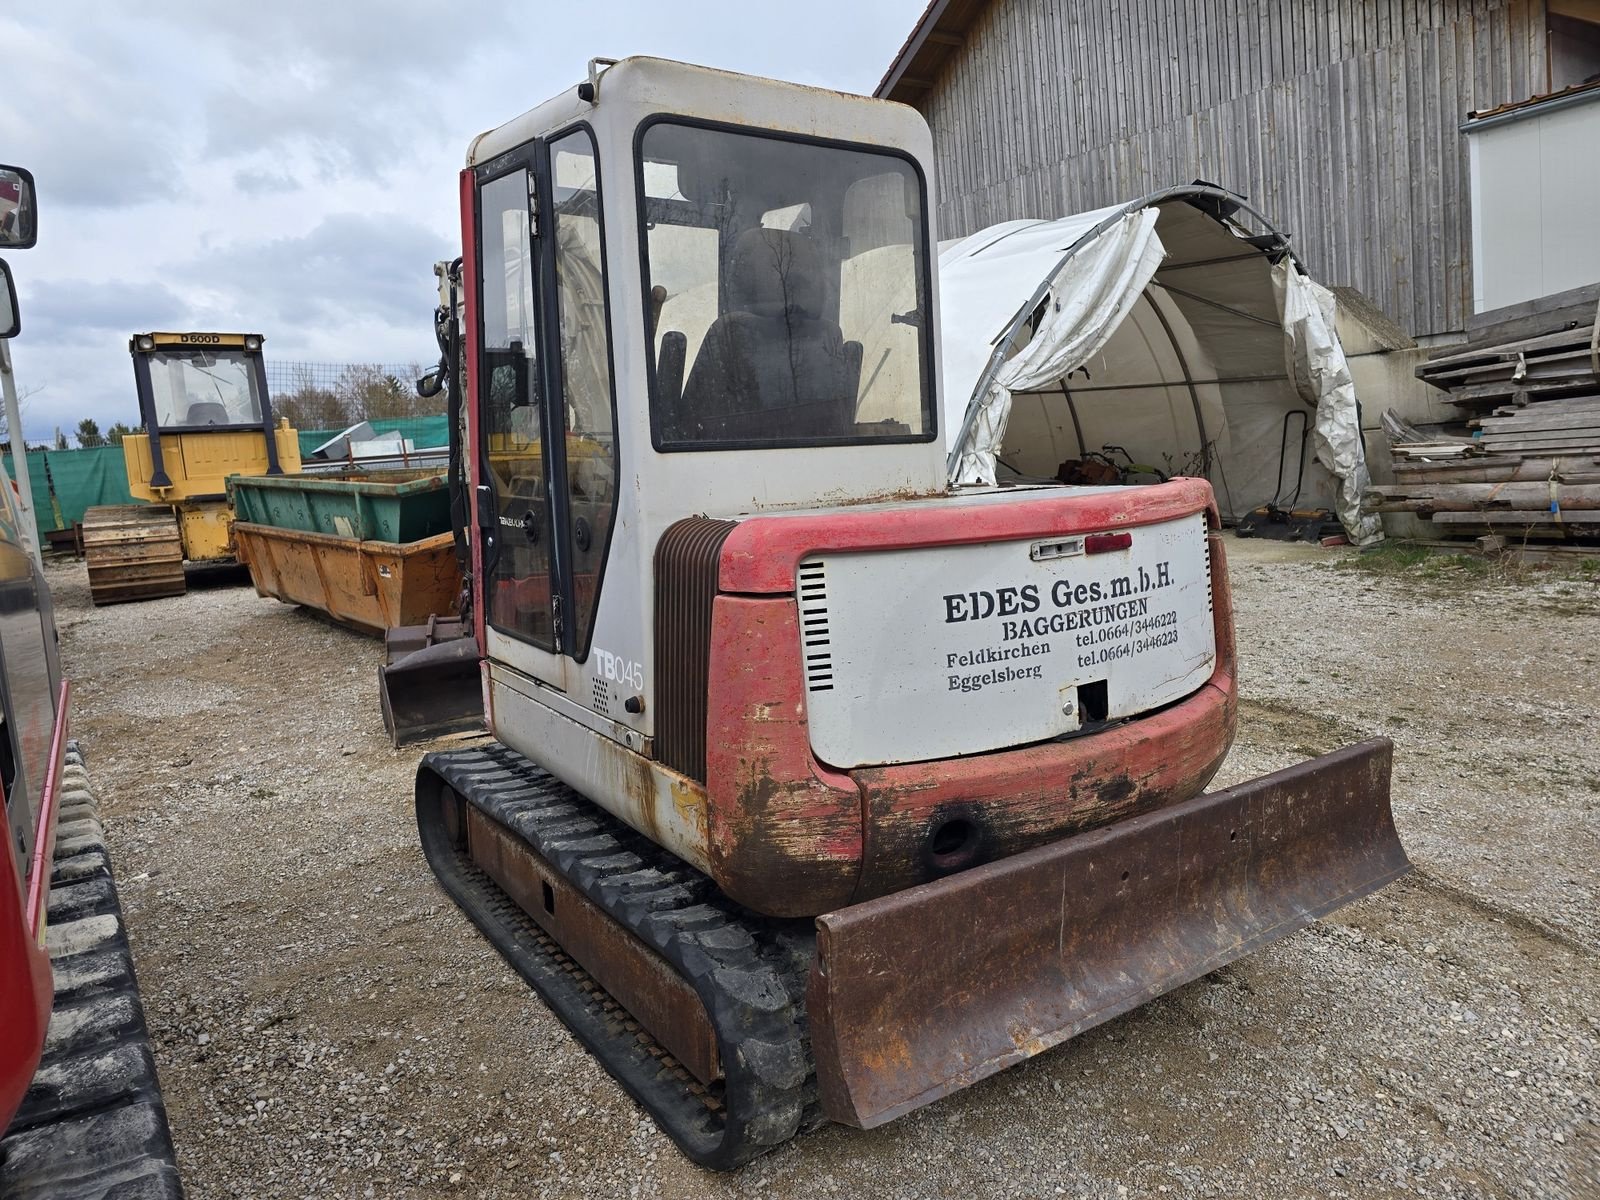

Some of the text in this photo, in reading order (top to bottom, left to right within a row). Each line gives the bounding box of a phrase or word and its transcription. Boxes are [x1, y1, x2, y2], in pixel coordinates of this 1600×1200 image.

[943, 561, 1174, 623] EDES Ges.m.b.H.
[1002, 597, 1148, 641] BAGGERUNGEN
[947, 611, 1177, 668] Feldkirchen tel.0664/3446222
[948, 630, 1178, 692] Eggelsberg tel.0664/3446223
[593, 647, 643, 690] TB045
